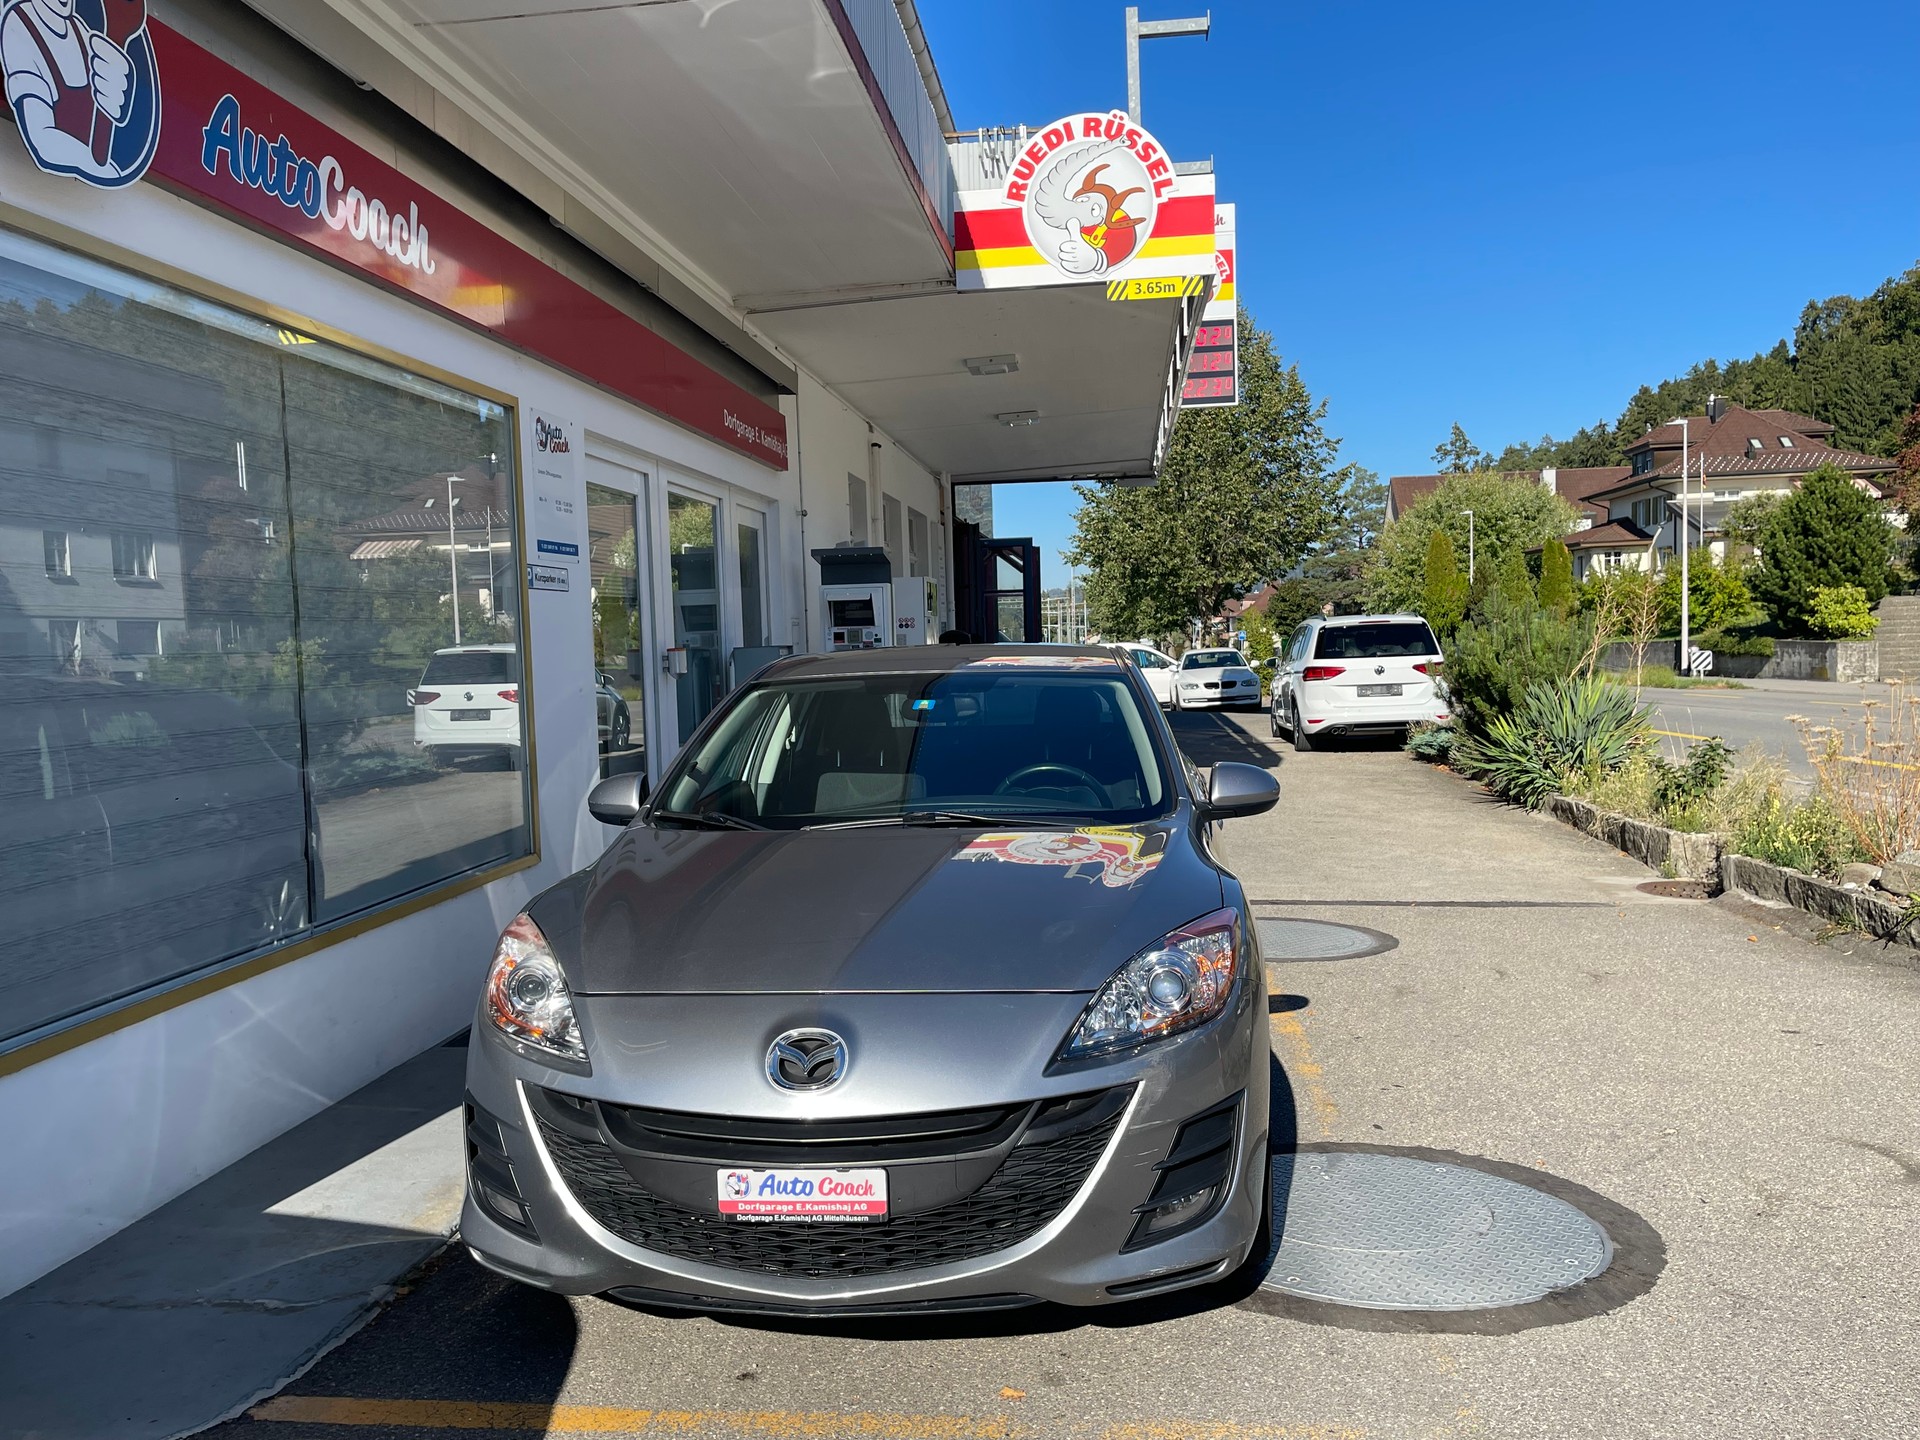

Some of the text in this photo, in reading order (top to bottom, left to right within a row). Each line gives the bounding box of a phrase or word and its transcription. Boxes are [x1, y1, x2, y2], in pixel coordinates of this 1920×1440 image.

[1006, 113, 1173, 203] RUEDI RÜSSEL
[1134, 280, 1177, 295] 3.65m
[546, 423, 563, 441] Auto
[723, 408, 755, 443] Dorfgarage
[549, 436, 571, 453] Coach
[758, 1173, 875, 1197] Auto Coach
[738, 1202, 868, 1212] Dorfgarage E.Kamishaj AG
[737, 1214, 773, 1222] Dorfgarage
[812, 1214, 823, 1222] AG
[823, 1214, 869, 1222] Mittelhäusern
